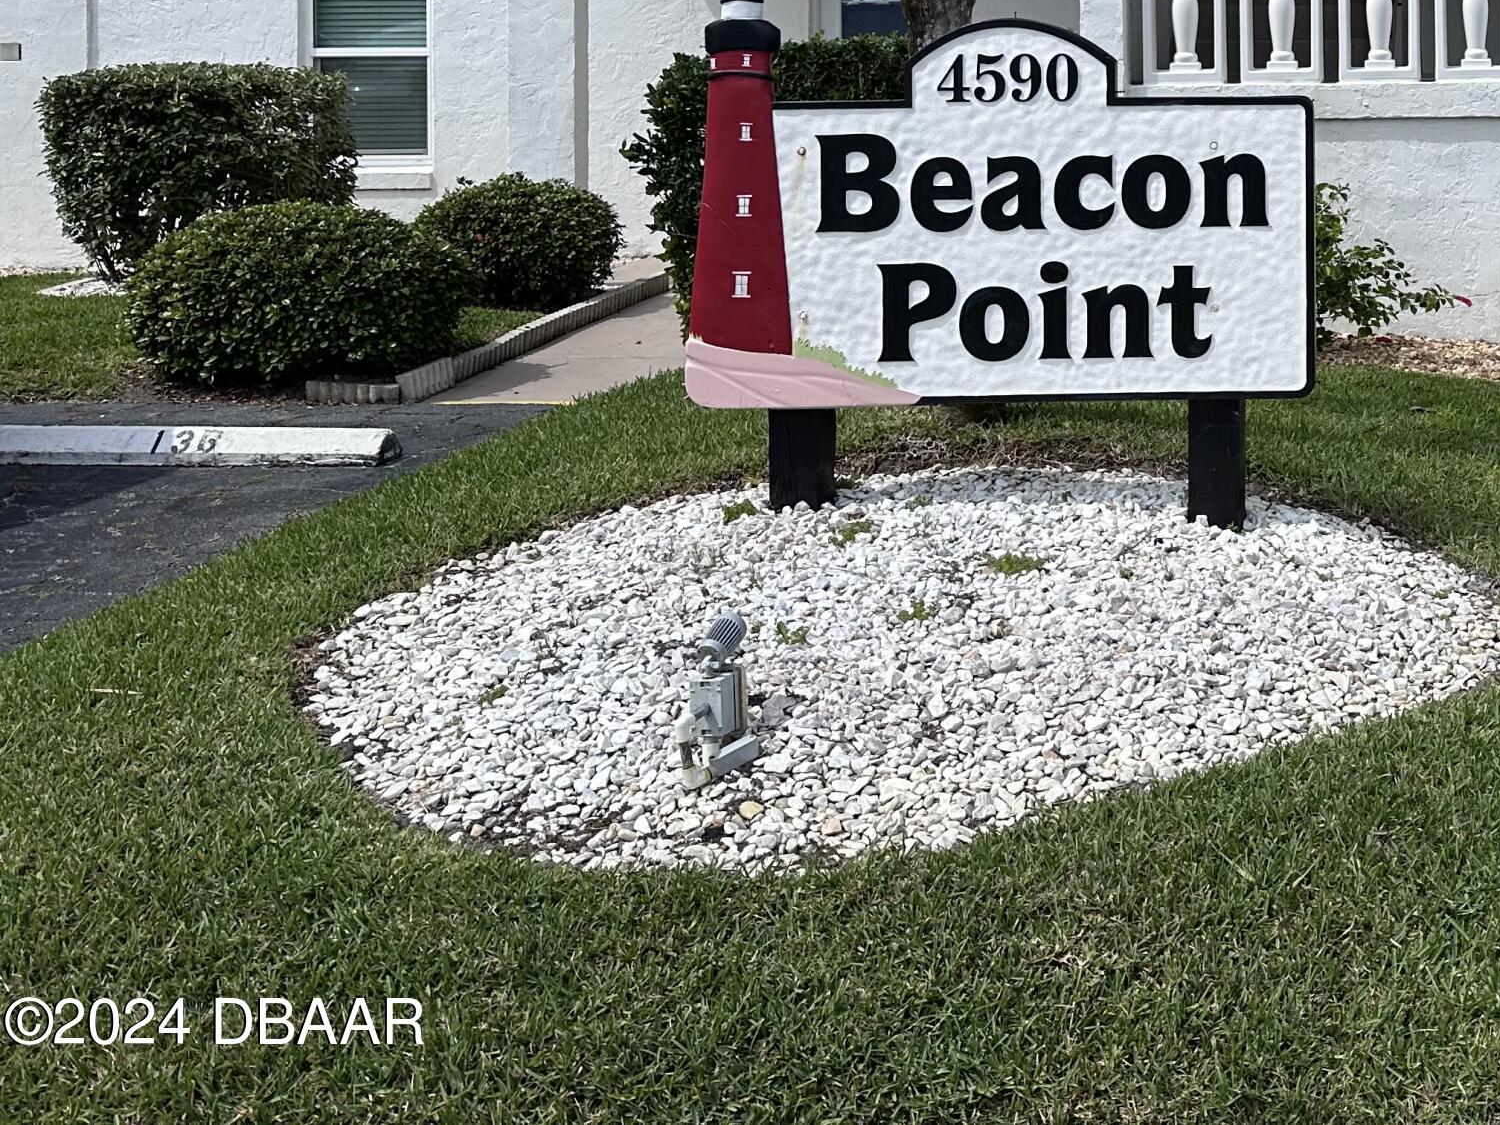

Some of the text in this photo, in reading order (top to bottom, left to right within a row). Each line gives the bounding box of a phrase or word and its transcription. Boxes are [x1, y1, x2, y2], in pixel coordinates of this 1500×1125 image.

[937, 52, 1080, 103] 4590
[815, 133, 1270, 233] Beacon
[876, 261, 1213, 363] Point
